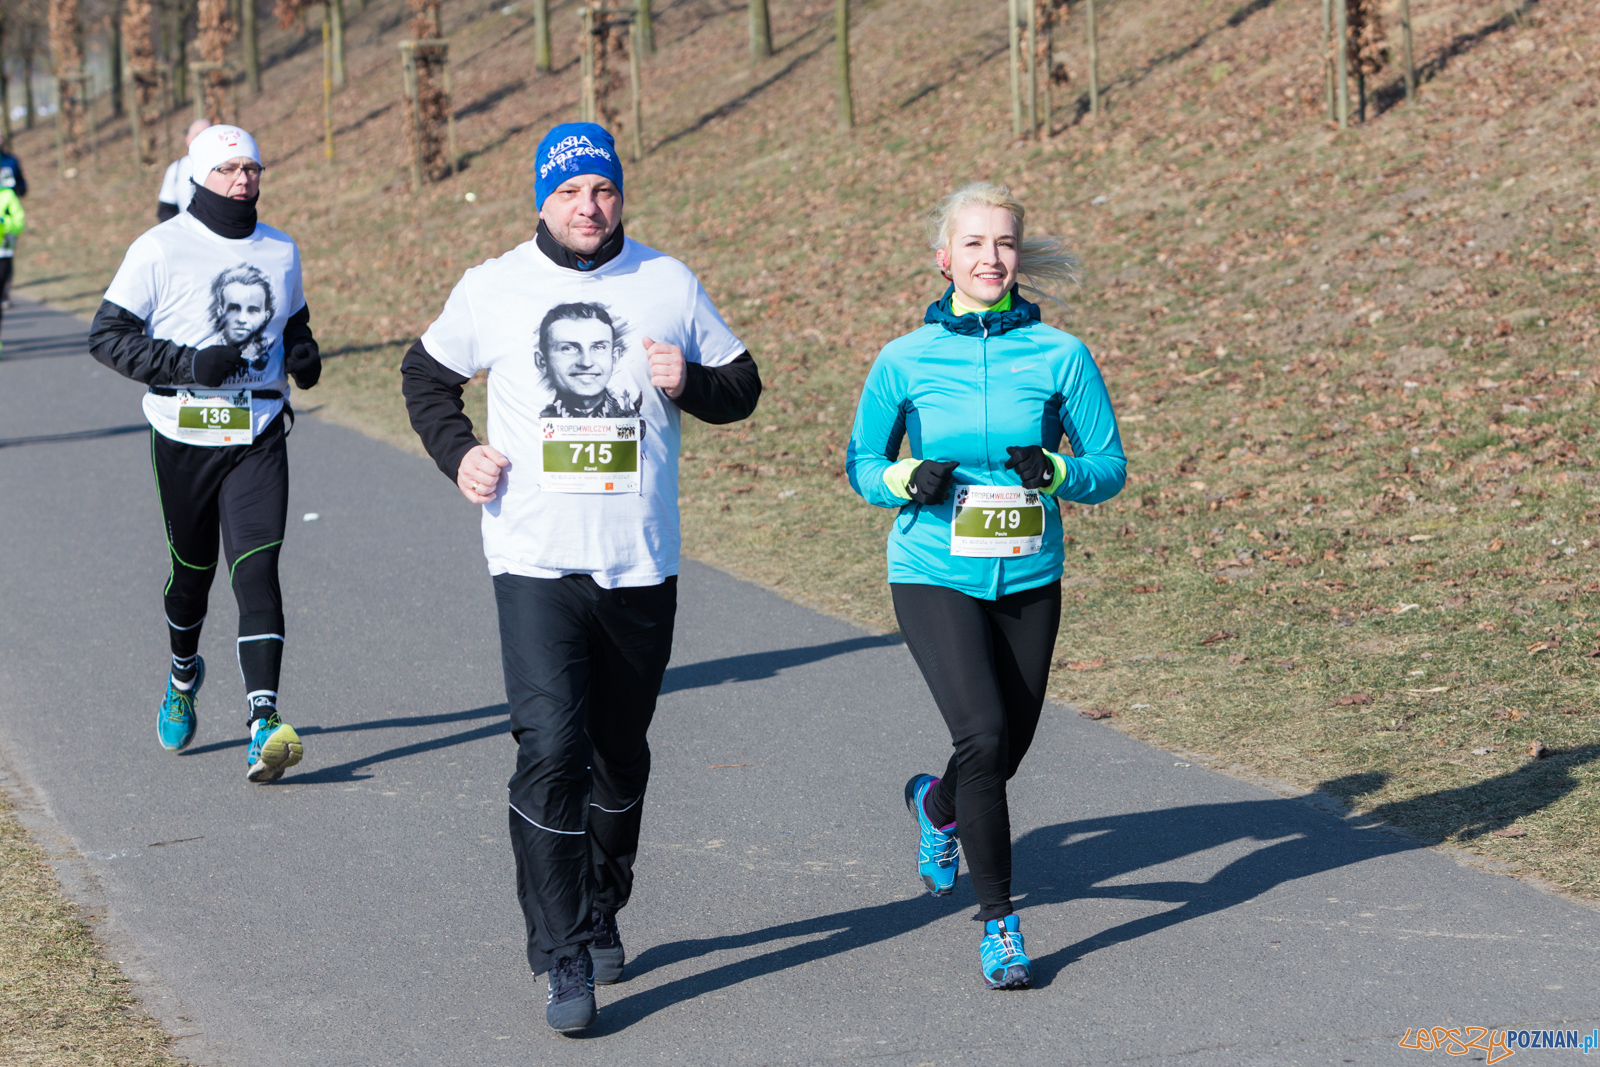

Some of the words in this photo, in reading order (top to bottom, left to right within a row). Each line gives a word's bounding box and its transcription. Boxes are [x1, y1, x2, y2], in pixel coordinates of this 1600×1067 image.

[200, 408, 231, 424] 136
[569, 443, 613, 464] 715
[982, 509, 1021, 530] 719
